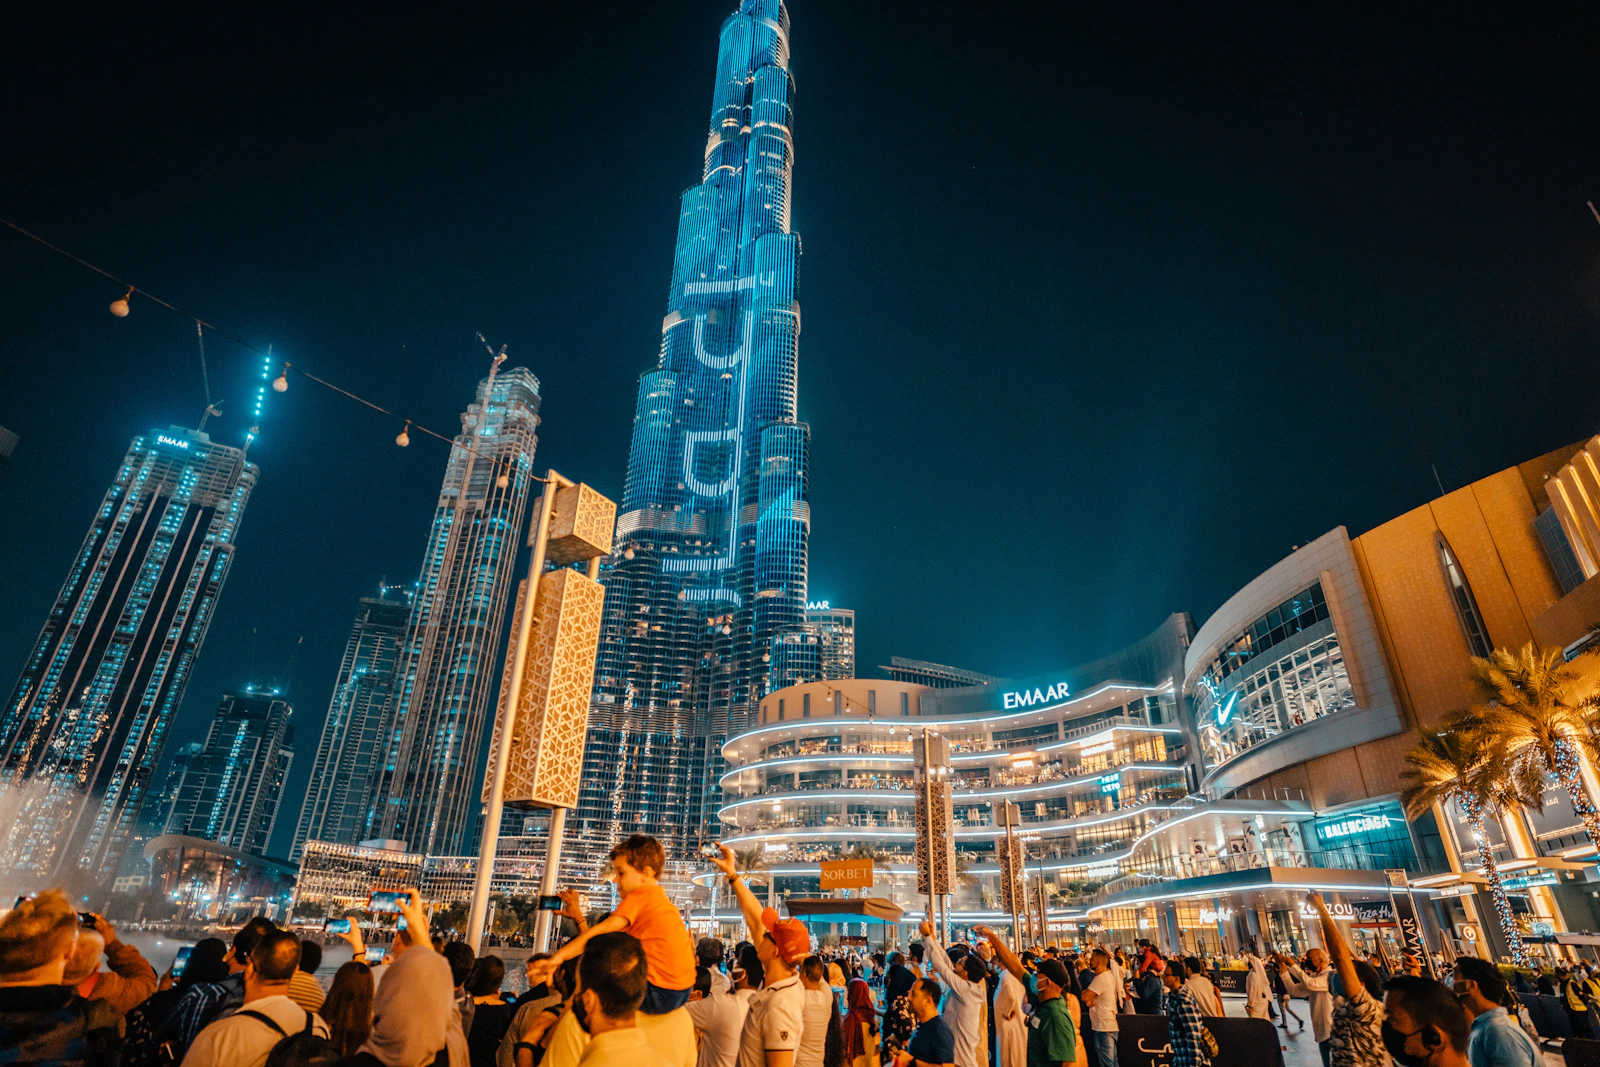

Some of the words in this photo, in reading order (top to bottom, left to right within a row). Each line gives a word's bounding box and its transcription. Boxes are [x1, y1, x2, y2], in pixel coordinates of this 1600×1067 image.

[157, 435, 189, 449] EMAAR
[1003, 682, 1070, 709] EMAAR
[1324, 814, 1391, 838] BALENCIAGA
[823, 867, 869, 881] SORBET
[1353, 905, 1377, 920] Pizza
[1402, 917, 1426, 967] EMAAR
